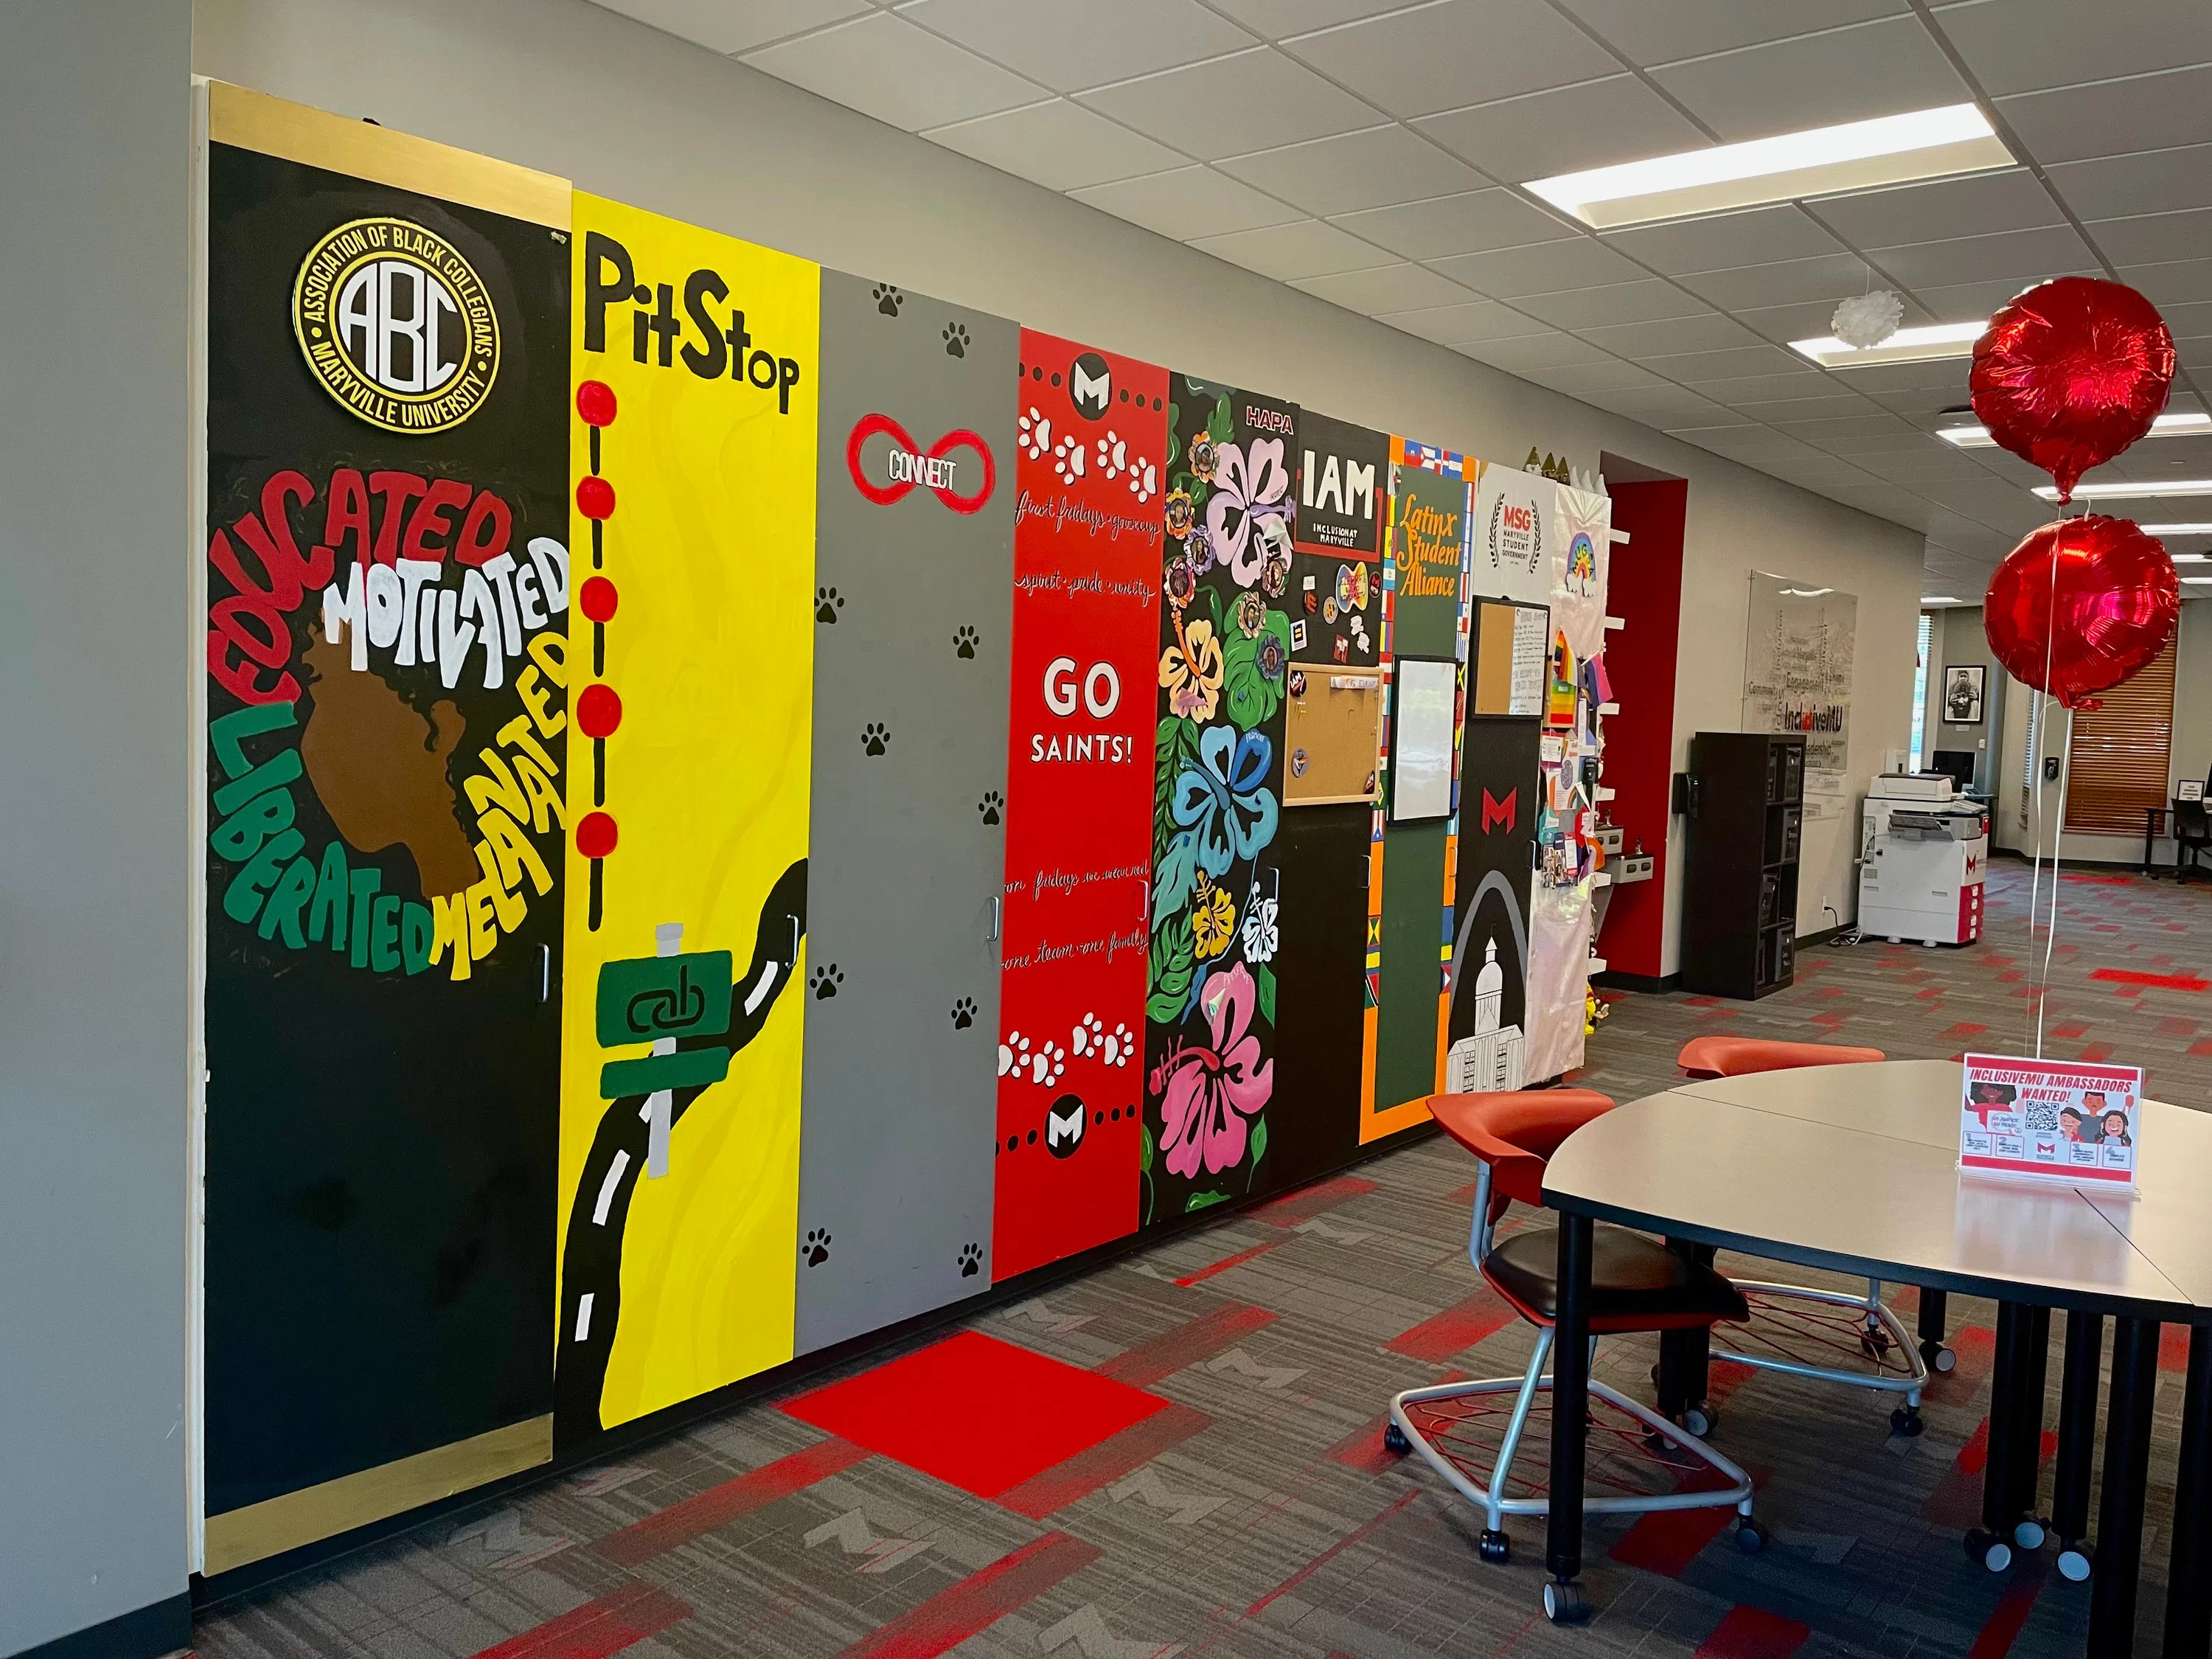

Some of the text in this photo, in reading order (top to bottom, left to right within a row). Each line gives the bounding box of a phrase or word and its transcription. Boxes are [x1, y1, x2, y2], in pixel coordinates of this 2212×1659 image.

[303, 226, 493, 358] ASSOCIATION OF BLACK COLLEGIANS
[338, 260, 458, 392] ABC
[311, 341, 487, 428] MARYVILLE UNIVERSITY
[1246, 406, 1294, 436] HAPA
[888, 448, 956, 490] CONNECT
[1015, 490, 1054, 526] first
[1057, 495, 1106, 537] fridays
[1400, 493, 1458, 538] Latinx
[1504, 505, 1531, 532] MSG
[1320, 533, 1354, 547] MARYVILLE
[1396, 527, 1461, 571] Student
[1502, 549, 1528, 560] GOVERNMENT
[1503, 529, 1529, 541] MARYVILLE
[1503, 539, 1528, 552] STUDENT
[207, 468, 513, 706] EDUCATED
[1015, 569, 1156, 608] spirit pride unity
[1400, 561, 1455, 597] Alliance
[322, 537, 569, 689] MOTIVATED
[1043, 655, 1121, 720] GO
[1030, 733, 1133, 765] SAINTS!
[209, 701, 436, 975] LIBERATED
[1004, 859, 1150, 902] on fridays we wear red
[1001, 928, 1150, 970] one team one family
[1969, 1068, 2132, 1093] INCLUSIVEMU AMBASSADORS
[2021, 1088, 2072, 1103] WANTED!
